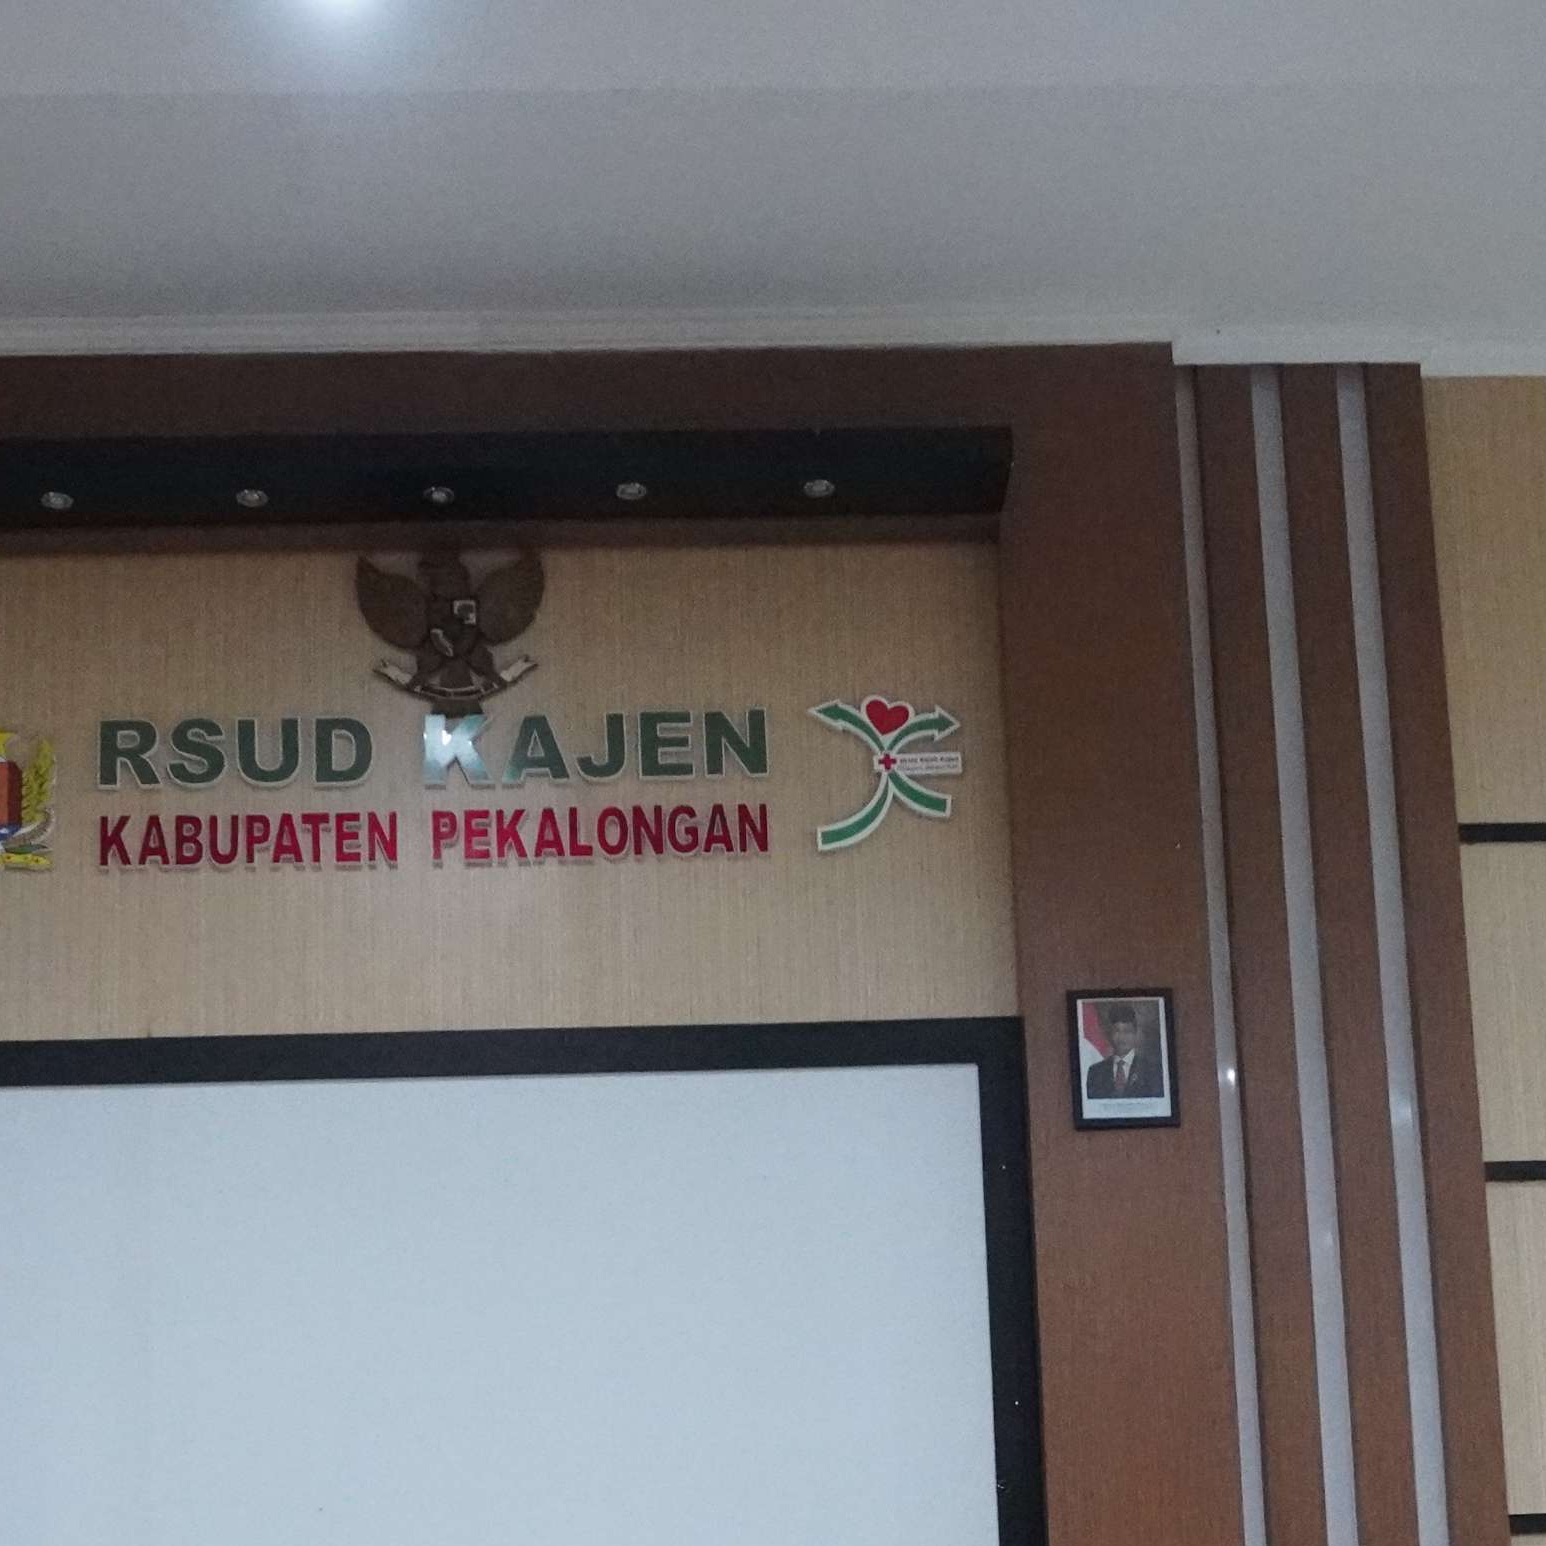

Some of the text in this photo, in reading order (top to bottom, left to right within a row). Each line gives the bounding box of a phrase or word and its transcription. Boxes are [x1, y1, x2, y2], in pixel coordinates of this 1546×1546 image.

[97, 707, 770, 788] RSUD KAJEN
[99, 803, 770, 868] KABUPATEN PEKALONGAN
